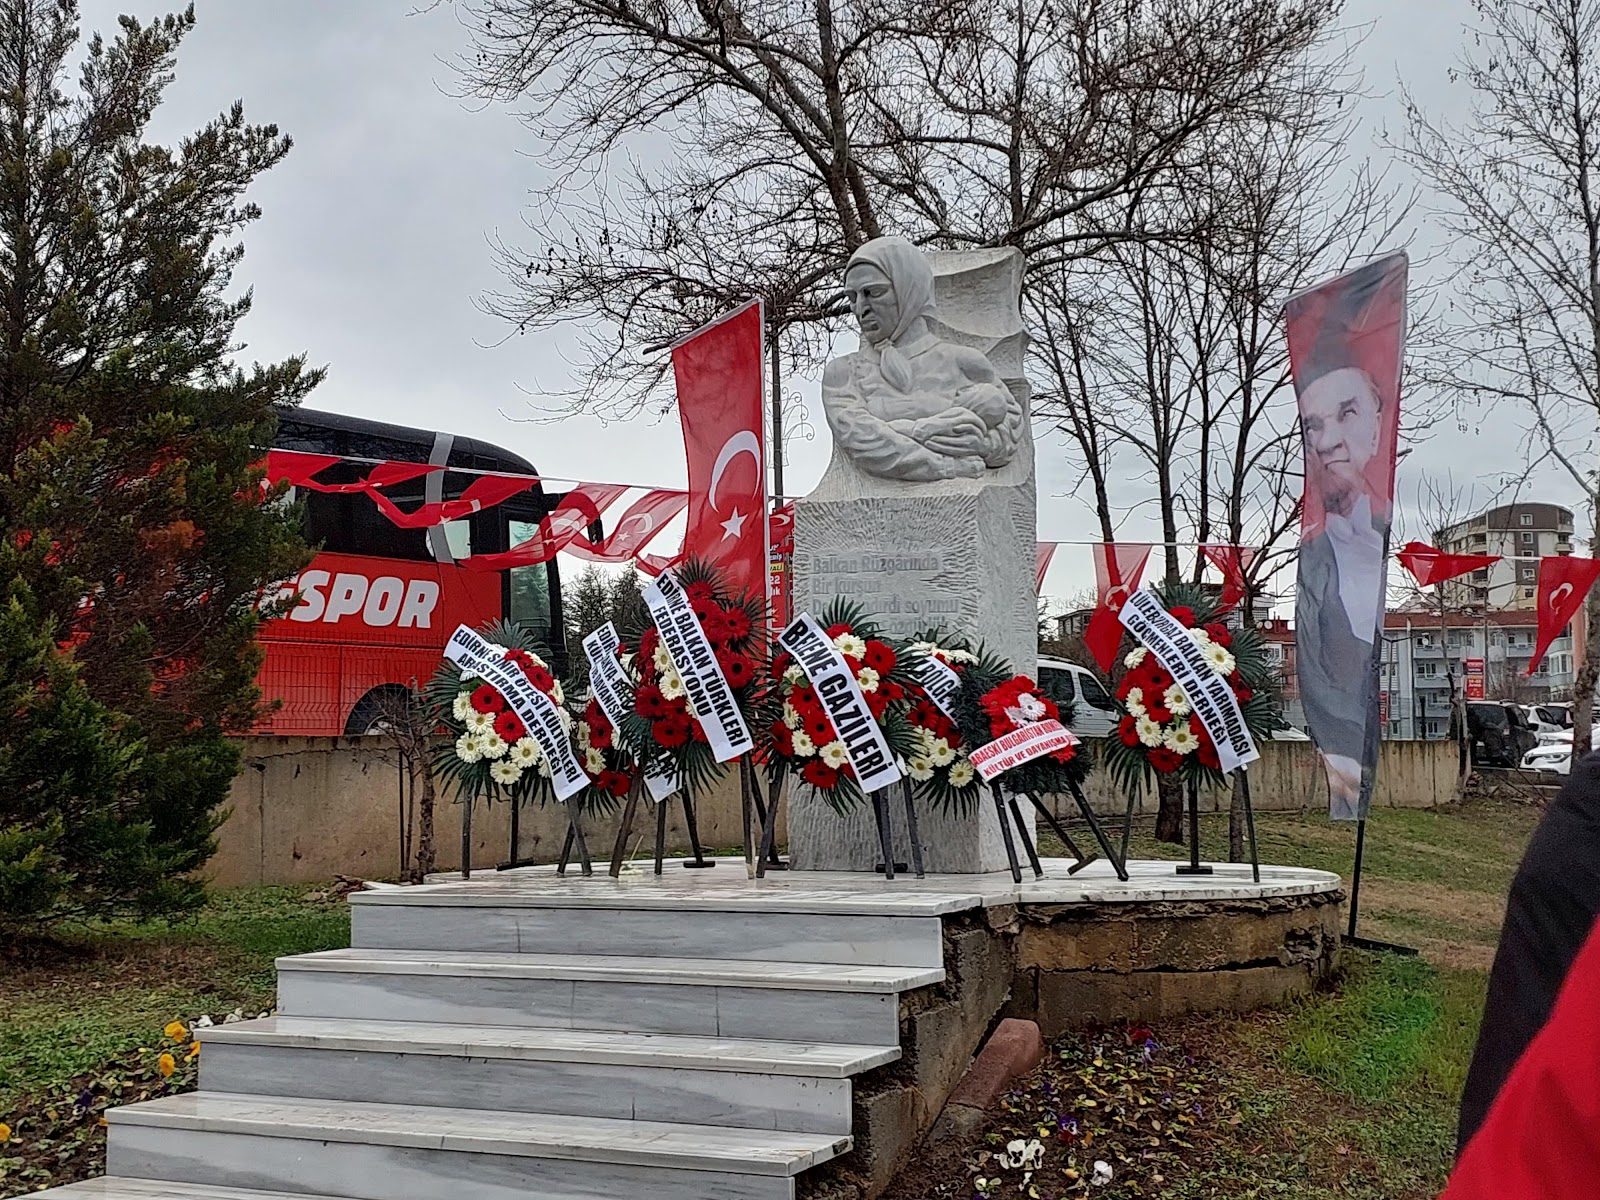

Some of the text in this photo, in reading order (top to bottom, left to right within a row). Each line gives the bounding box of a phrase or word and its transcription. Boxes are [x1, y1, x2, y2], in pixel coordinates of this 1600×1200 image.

[597, 625, 617, 655] EDİR
[653, 606, 712, 717] FEDERASYONU
[674, 611, 712, 669] BALKAN
[701, 668, 749, 747] TÜRKLERİ
[515, 676, 547, 710] ÖTESİ
[540, 708, 582, 784] KÜLTÜRLERİ
[818, 673, 894, 781] GAZİLERİ
[970, 742, 1002, 768] ABAESKİ
[1000, 724, 1042, 751] BULGARİSTAN
[1173, 636, 1214, 682] BALKAN
[1205, 679, 1250, 757] YARIMADASI
[983, 755, 1016, 776] KÜLTÜR
[1015, 751, 1026, 762] VE
[1025, 736, 1067, 757] DAYANIŞMA
